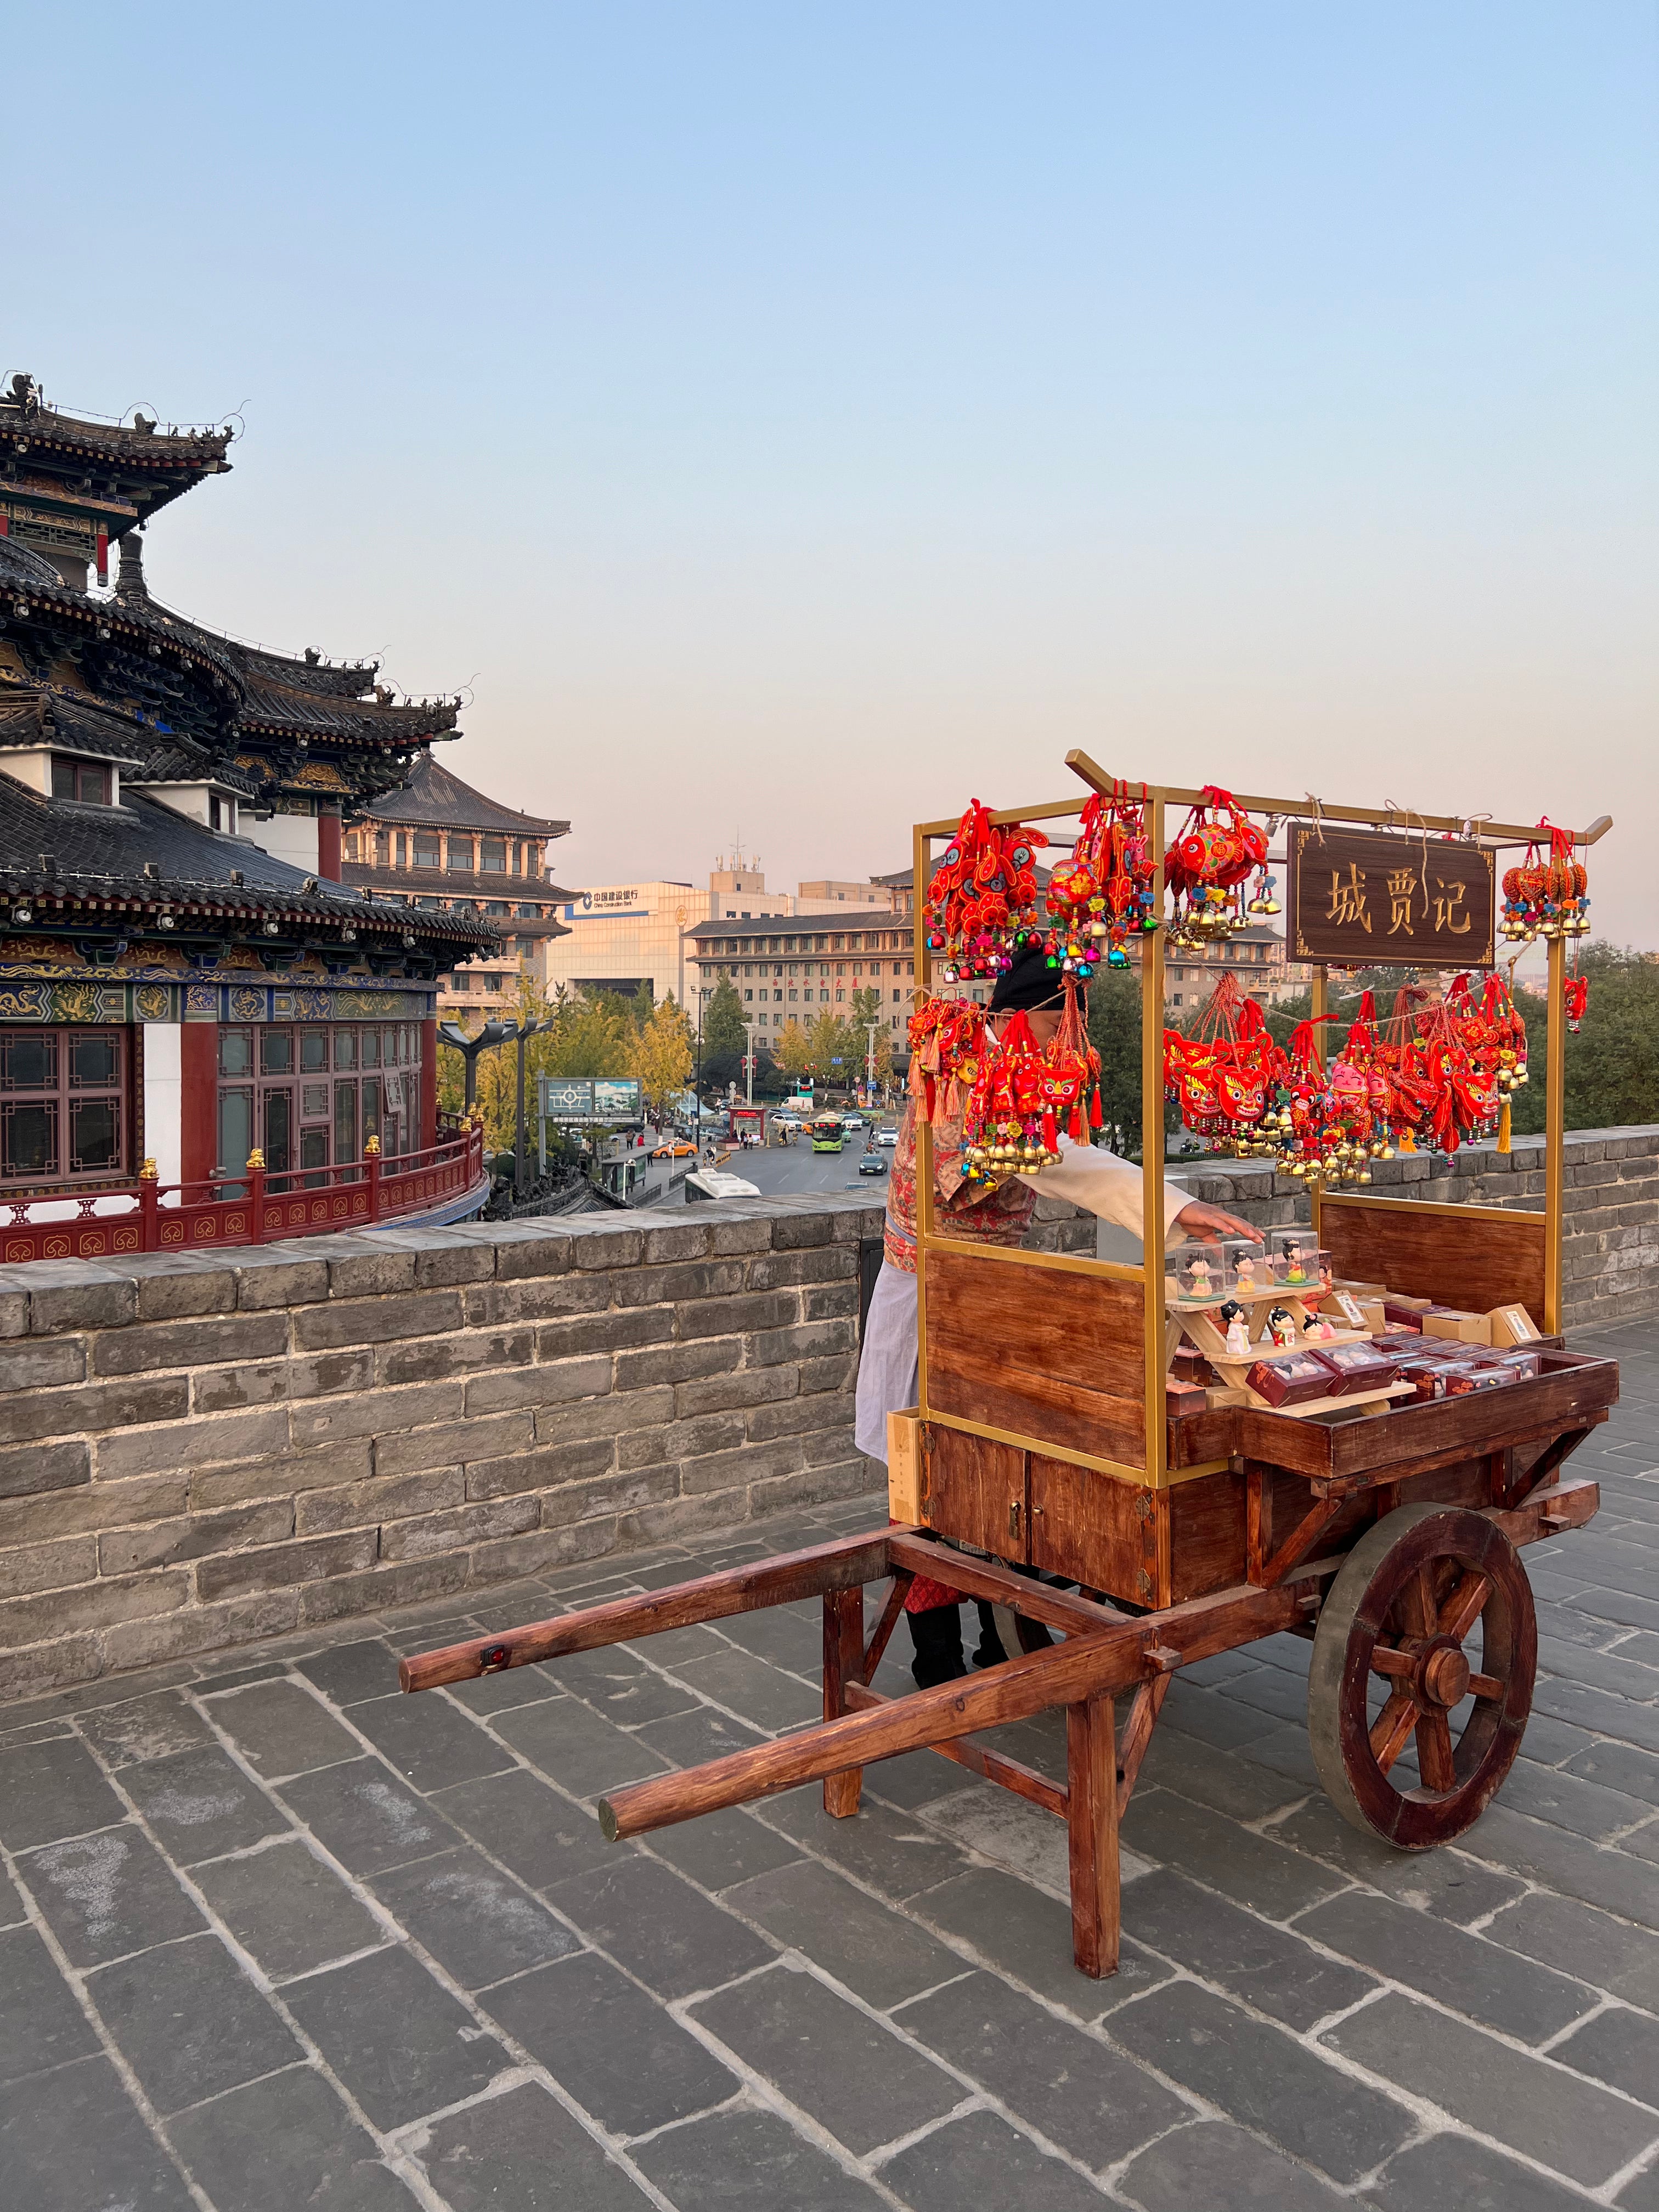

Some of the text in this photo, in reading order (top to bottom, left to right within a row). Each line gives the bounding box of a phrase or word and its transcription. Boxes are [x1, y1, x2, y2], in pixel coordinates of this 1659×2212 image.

[1213, 844, 1226, 855] 福
[1069, 872, 1091, 895] 福
[594, 889, 638, 901] 中国建设银行
[1325, 861, 1471, 935] 城贾记
[772, 977, 859, 988] 西北水电大厦
[1385, 1053, 1397, 1063] 福
